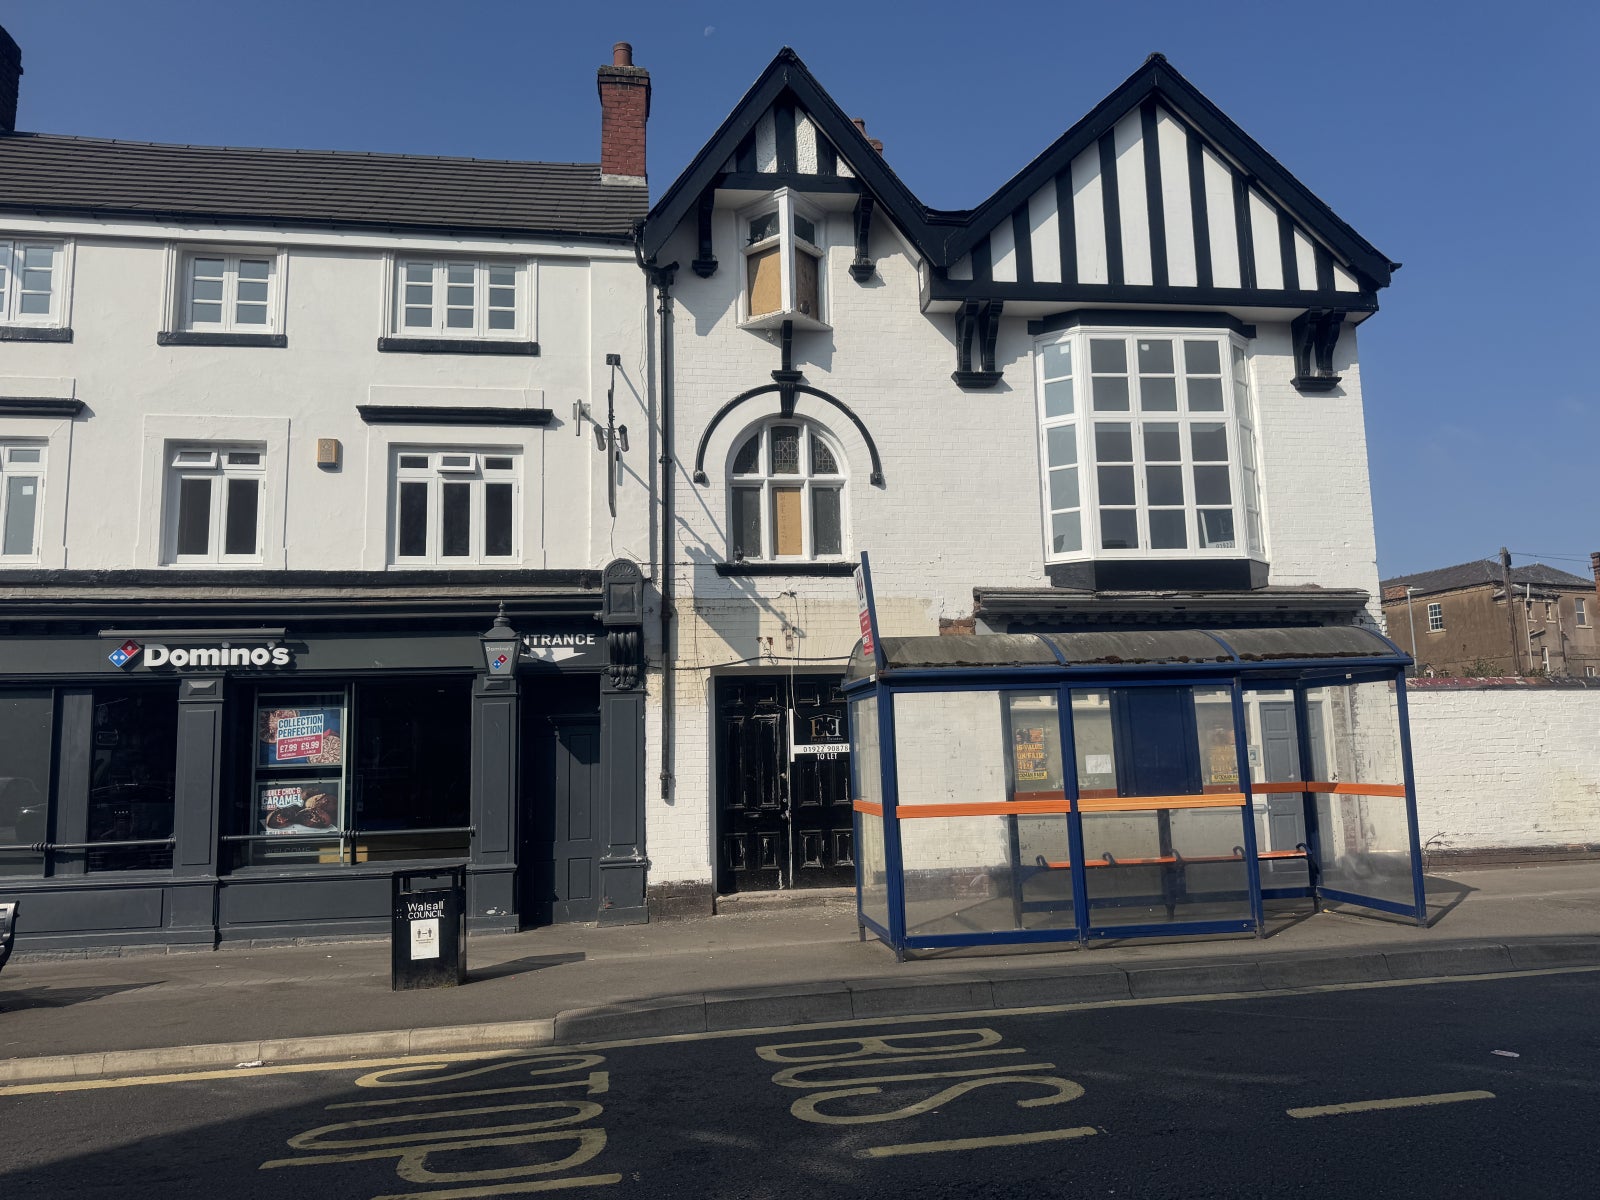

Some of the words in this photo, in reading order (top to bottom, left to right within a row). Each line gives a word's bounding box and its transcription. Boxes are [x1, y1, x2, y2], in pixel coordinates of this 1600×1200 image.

[523, 633, 596, 646] NTRANCE
[143, 641, 290, 667] Domino's
[278, 714, 323, 728] COLLECTION
[278, 724, 323, 738] PERFECTION
[280, 743, 298, 753] £7.99
[301, 741, 320, 751] £9.99
[827, 752, 838, 760] LET
[262, 794, 303, 806] CARAMEL
[407, 901, 443, 912] Walsall
[408, 910, 444, 919] COUNCIL
[756, 1028, 1085, 1125] BUS
[259, 1054, 610, 1183] STOP
